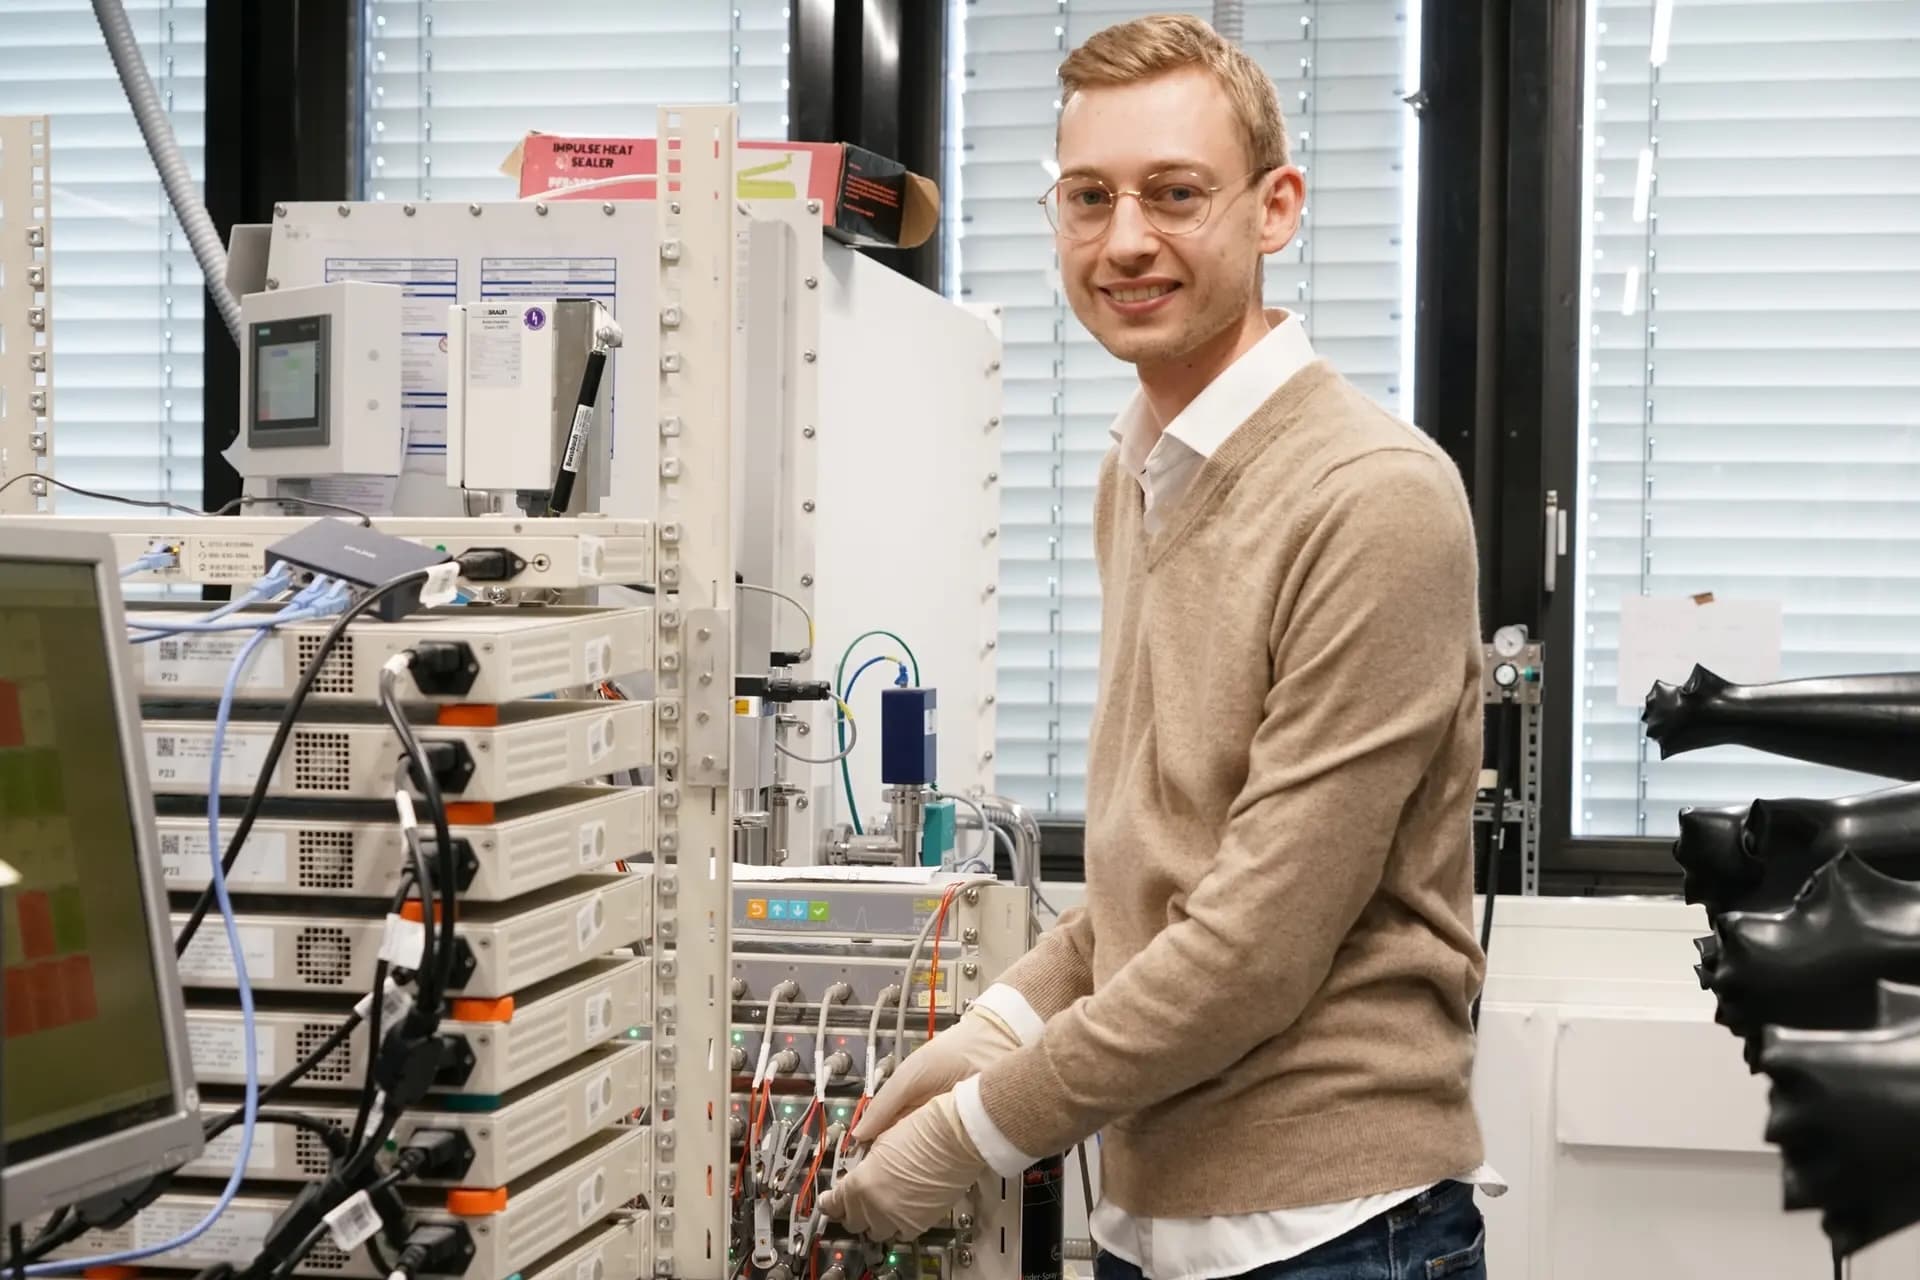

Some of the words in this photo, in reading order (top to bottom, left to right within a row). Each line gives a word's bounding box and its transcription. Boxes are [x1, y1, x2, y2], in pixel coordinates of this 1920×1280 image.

[553, 143, 600, 155] IMPULSE
[602, 145, 633, 155] HEAT
[571, 157, 614, 168] SEALER
